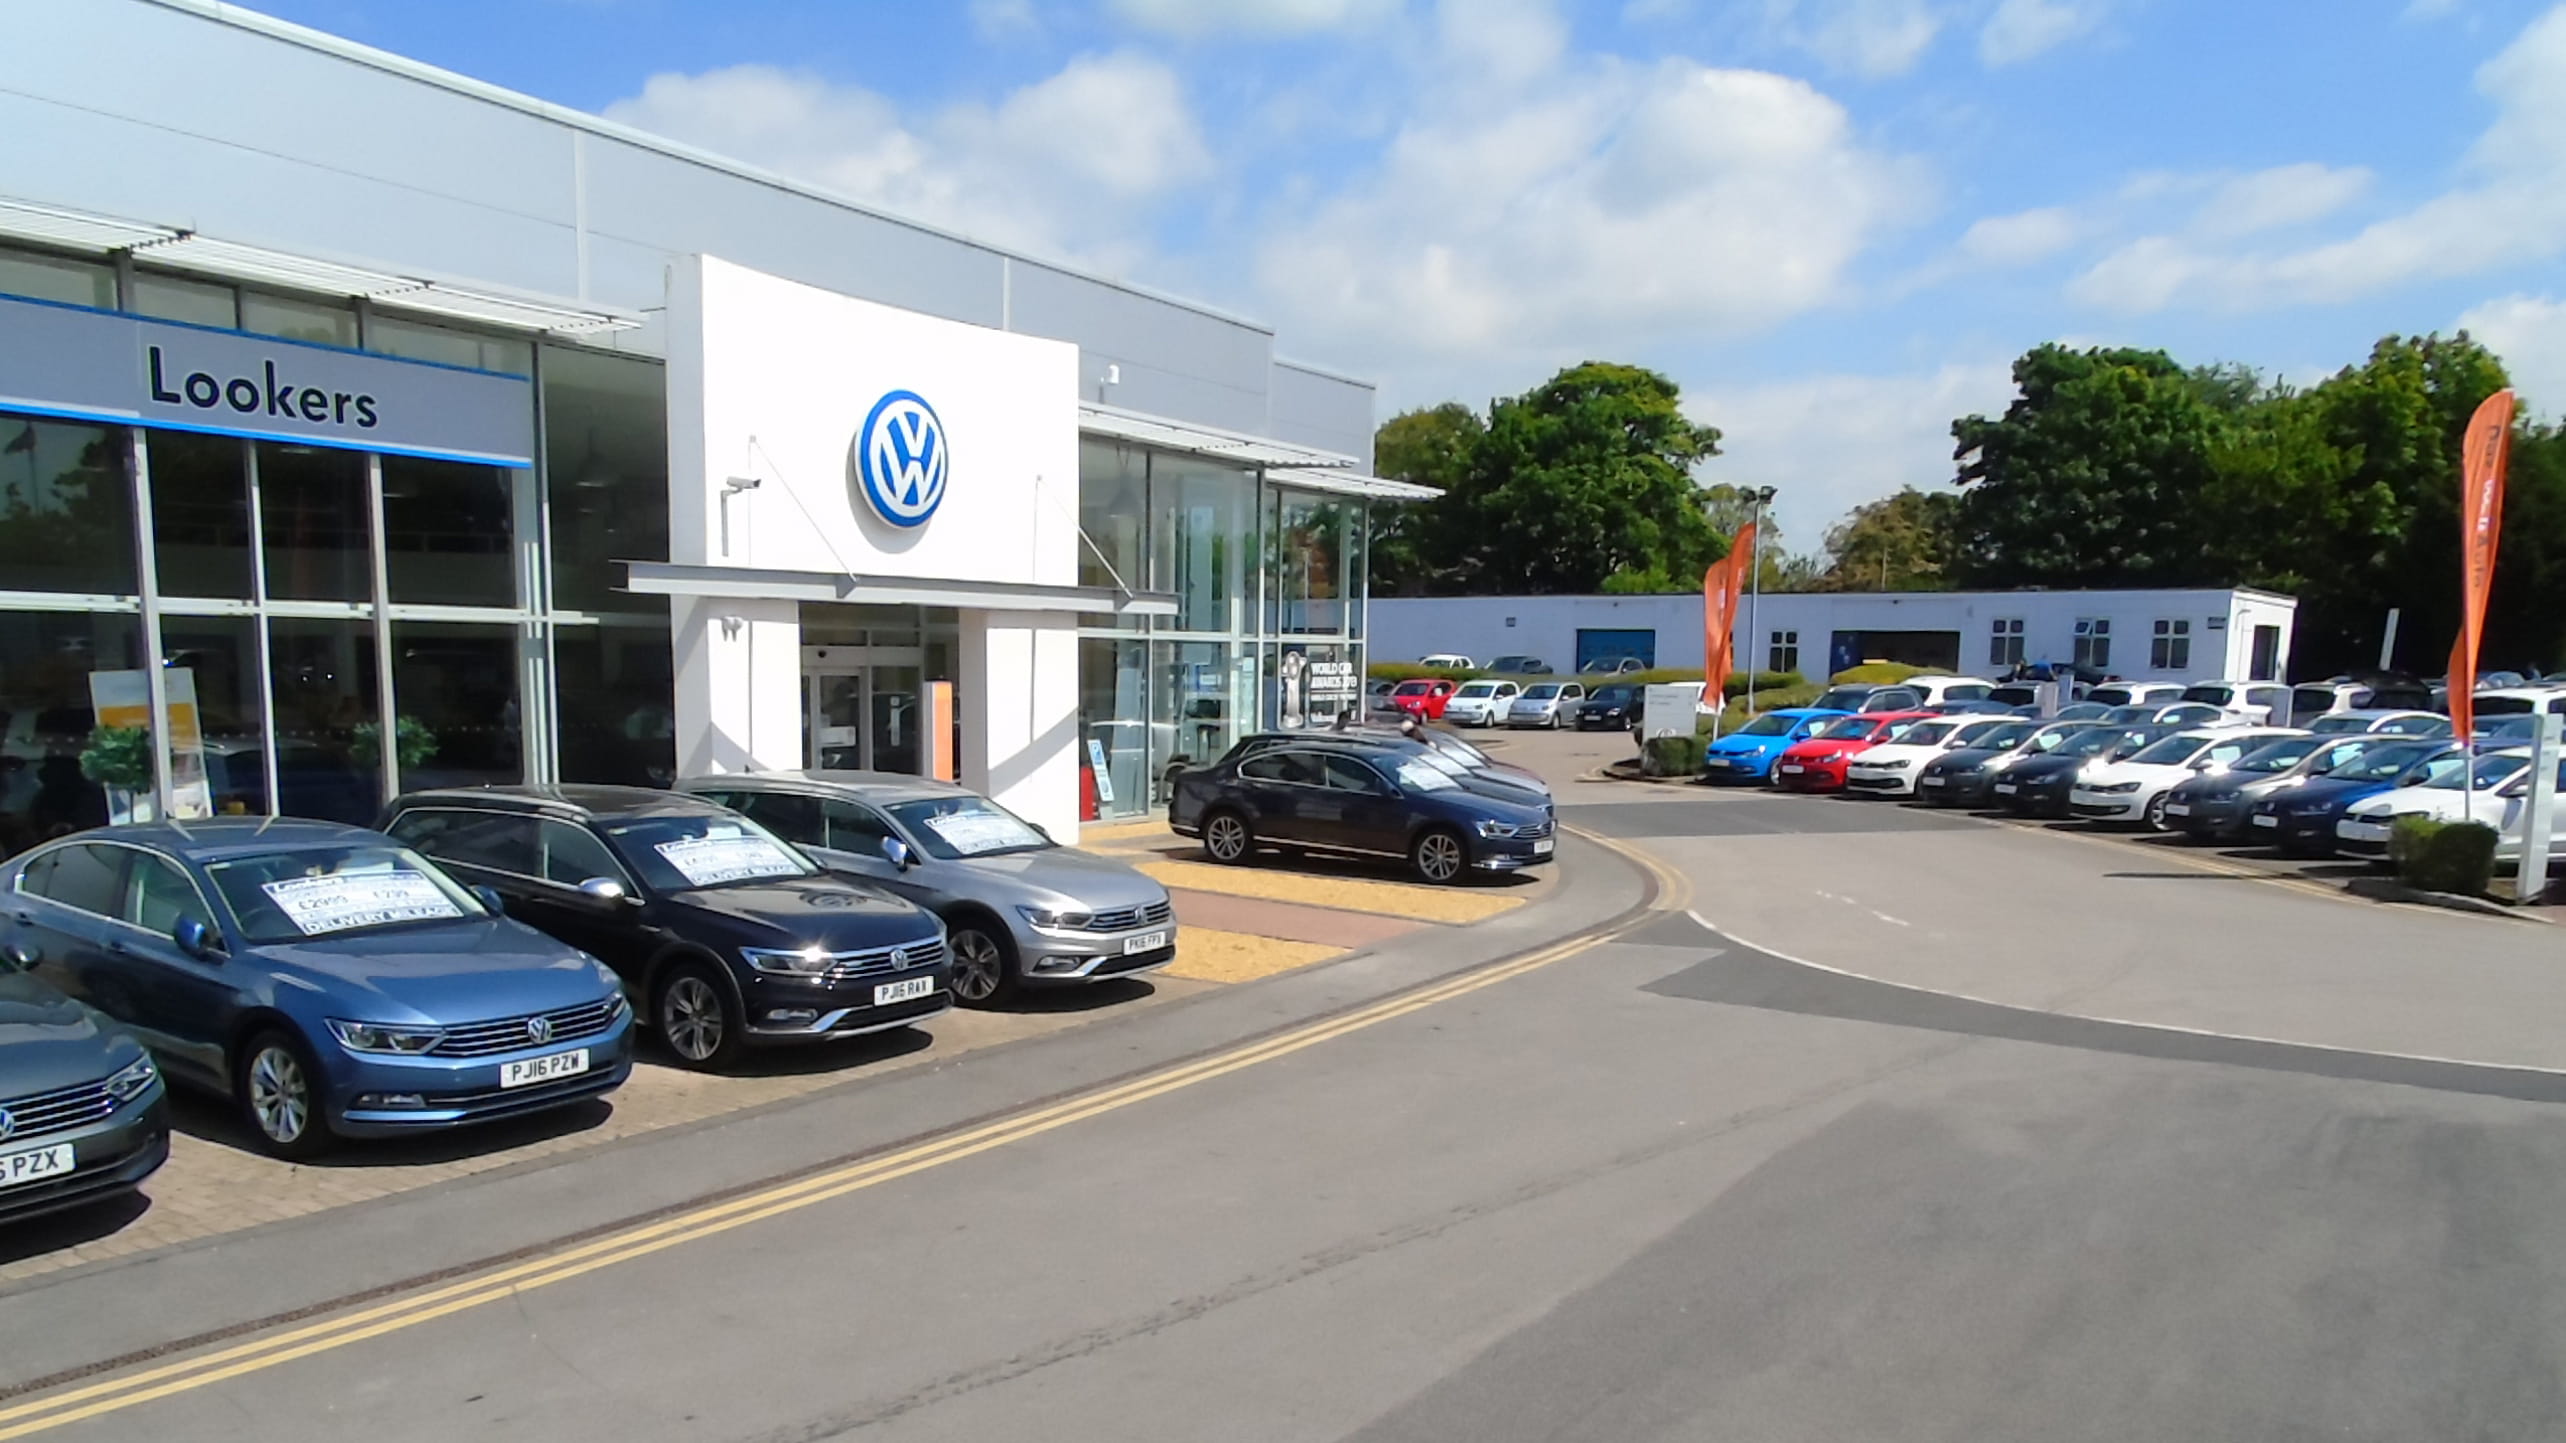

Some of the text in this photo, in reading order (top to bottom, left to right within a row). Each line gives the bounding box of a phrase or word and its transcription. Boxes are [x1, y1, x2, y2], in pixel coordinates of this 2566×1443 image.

[149, 345, 378, 428] Lookers
[1310, 662, 1353, 676] WORLD CAR
[1310, 676, 1341, 689] AWARDS
[882, 983, 906, 1001] PJ16
[511, 1053, 579, 1081] PJ16 PZW
[12, 1149, 59, 1177] PZX
